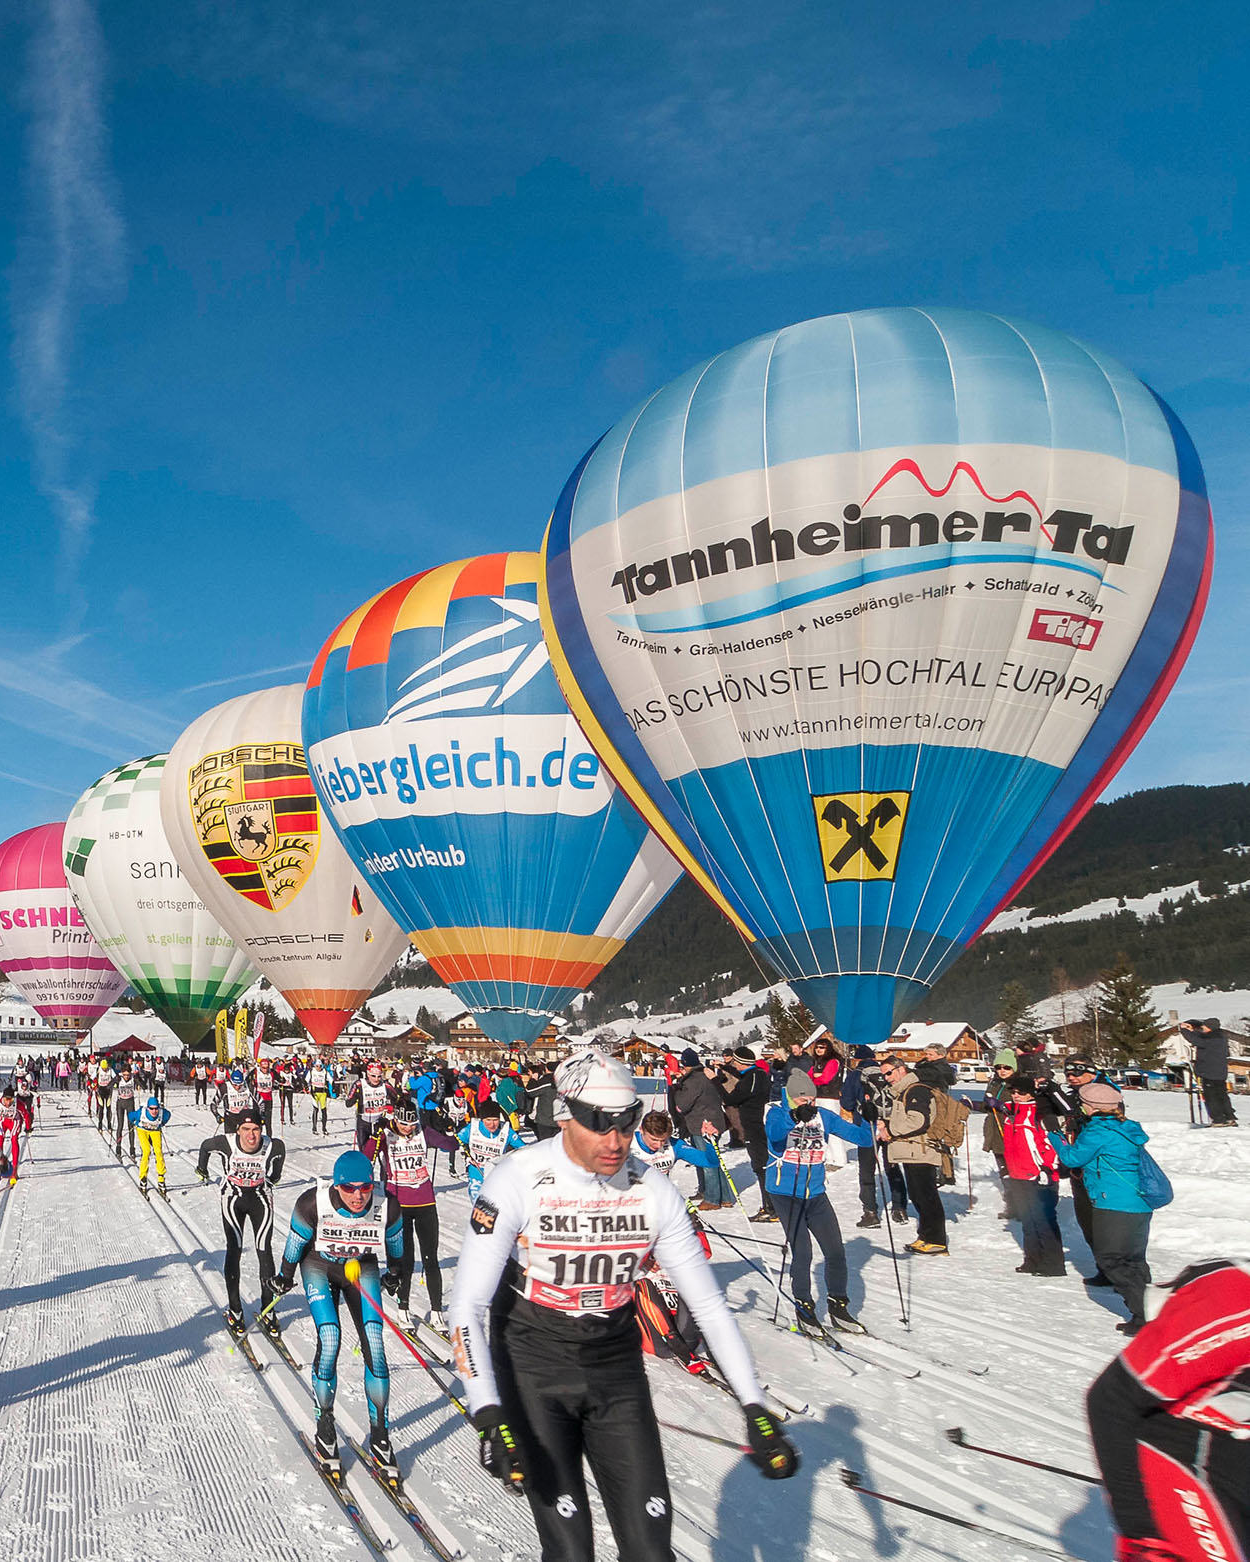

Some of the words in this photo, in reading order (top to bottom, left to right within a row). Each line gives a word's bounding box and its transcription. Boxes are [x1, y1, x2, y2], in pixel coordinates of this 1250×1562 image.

[611, 504, 1031, 604] Tannheimer
[668, 666, 828, 717] SCHÖNSTE
[840, 658, 986, 688] HOCHTAL
[191, 746, 306, 785] PORSCHE
[227, 803, 269, 816] STUTTGART
[398, 843, 466, 869] Urlaub
[245, 934, 344, 946] PORSCHE
[316, 953, 342, 961] Allgäu
[396, 1157, 423, 1170] 1124
[472, 1207, 494, 1228] TBC
[540, 1215, 650, 1233] SKI-TRAIL
[323, 1228, 379, 1238] SKI-TRAIL
[549, 1252, 638, 1286] 1103
